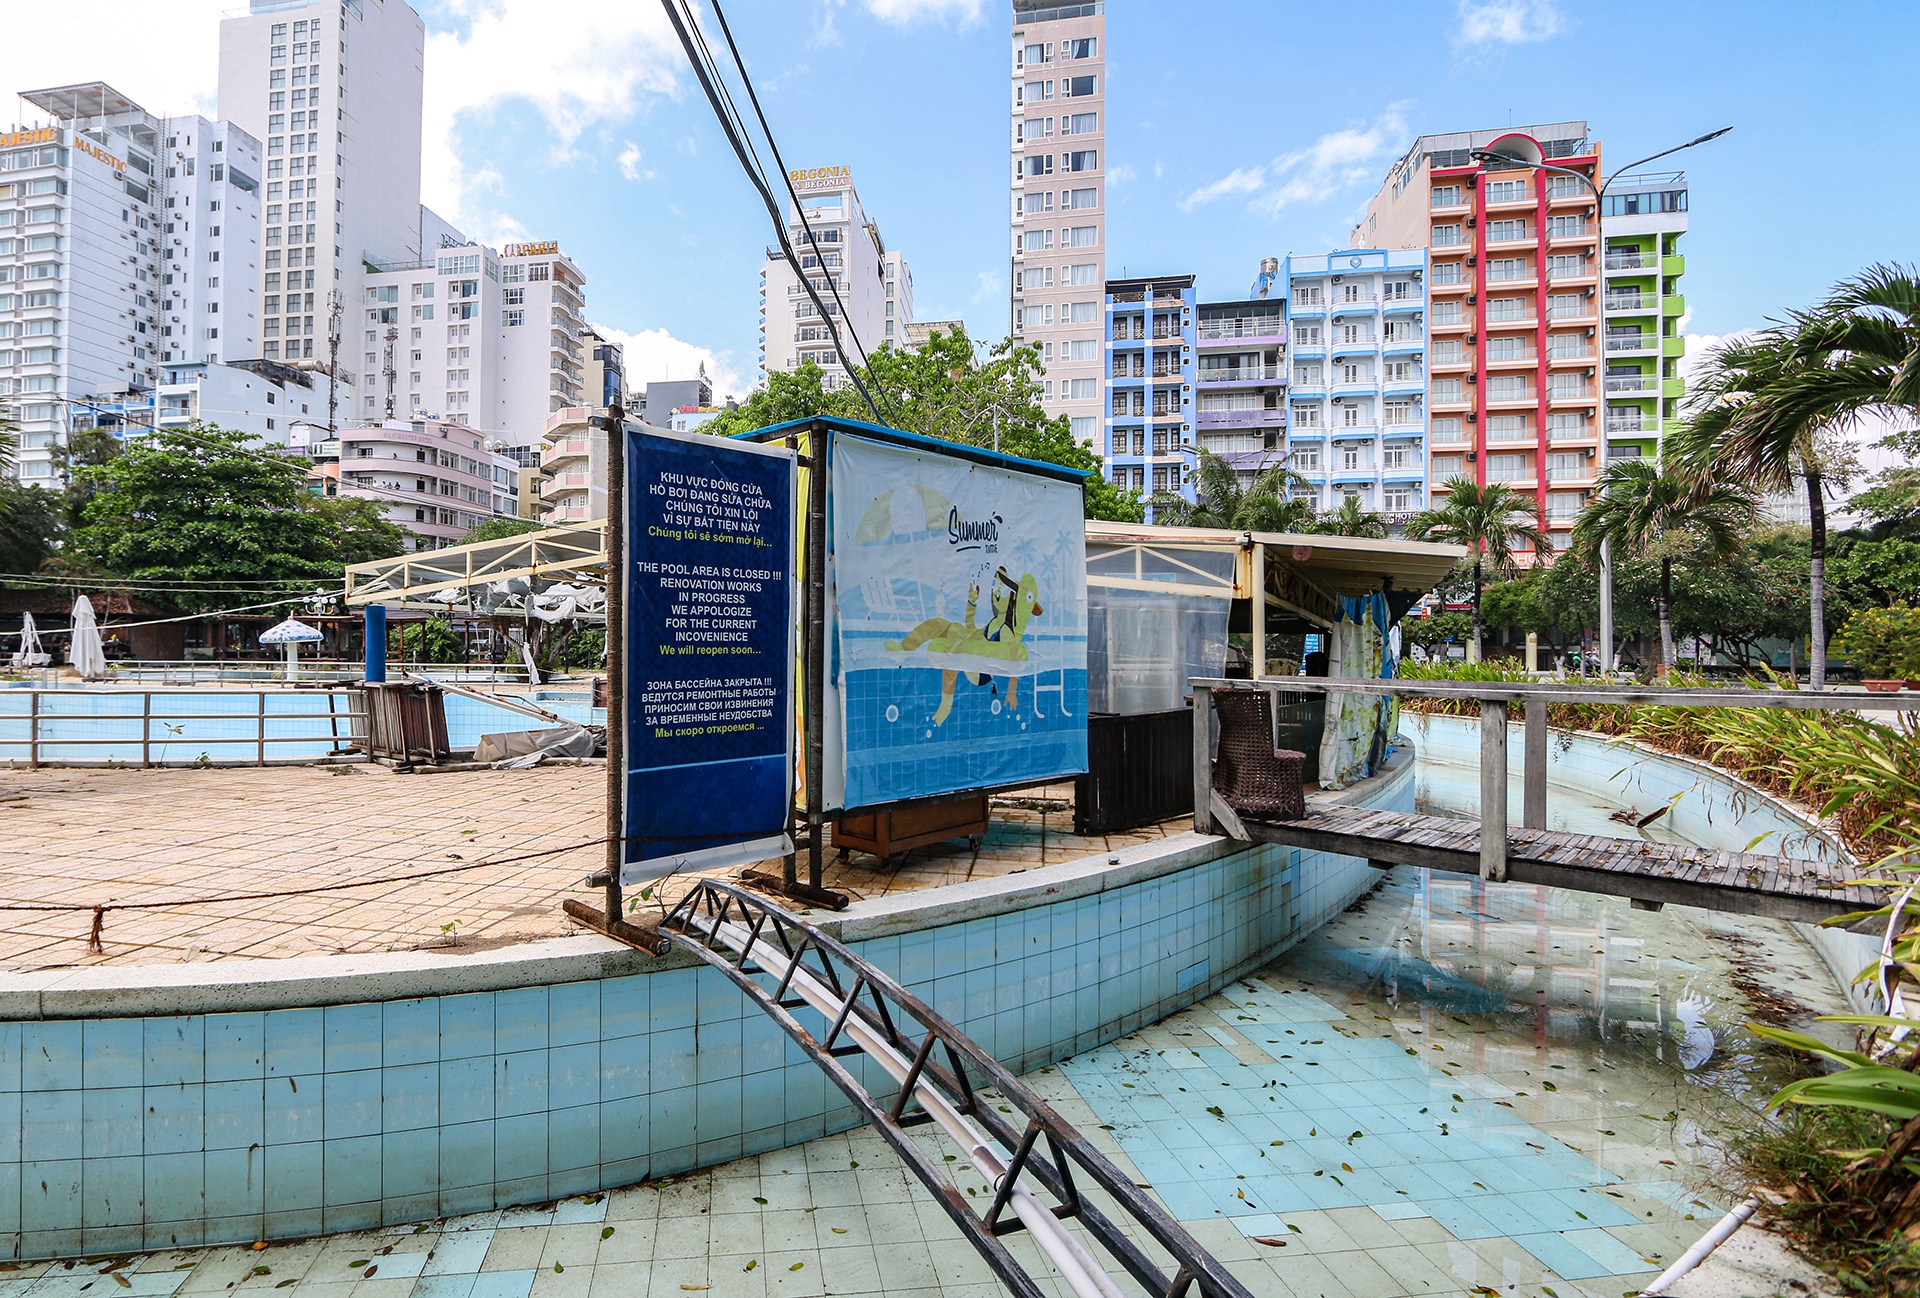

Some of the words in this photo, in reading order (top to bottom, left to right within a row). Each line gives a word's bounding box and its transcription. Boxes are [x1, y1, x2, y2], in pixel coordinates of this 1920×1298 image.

[75, 135, 128, 174] MAJESTIC
[790, 165, 850, 181] BEGONIA
[805, 178, 845, 189] BEGONIA
[522, 241, 558, 256] PARIS
[661, 472, 683, 484] KHU
[686, 475, 708, 488] VỰC
[710, 478, 739, 492] ĐÓNG
[742, 483, 763, 495] CỬA
[668, 486, 688, 498] BƠI
[690, 489, 719, 502] ĐANG
[722, 492, 743, 506] SỬA
[744, 497, 772, 509] CHỮA
[665, 500, 703, 513] CHÚNG
[706, 504, 722, 516] TÔI
[724, 507, 740, 518] XIN
[743, 508, 758, 520] LỖI
[663, 512, 673, 524] VÌ
[676, 515, 692, 528] SỰ
[717, 519, 739, 532] TIỆN
[741, 521, 761, 533] NÀY
[948, 504, 999, 545] Summer
[648, 525, 682, 541] Chúng
[684, 529, 697, 540] tôi
[699, 531, 711, 541] sẽ
[713, 532, 734, 543] sớm
[736, 535, 751, 545] mở
[637, 561, 659, 574] THE
[661, 563, 690, 575] POOL
[692, 565, 720, 577] AREA
[721, 566, 731, 578] IS
[733, 568, 771, 580] CLOSED
[660, 578, 725, 590] RENOVATION
[727, 580, 762, 592] WORKS
[679, 592, 689, 602] IN
[692, 592, 746, 604] PROGRESS
[671, 605, 688, 615] WE
[690, 605, 752, 617] APPOLOGIZE
[665, 618, 687, 628] FOR
[689, 619, 710, 629] THE
[711, 619, 757, 629] CURRENT
[675, 631, 748, 642] INCOVENIENCE
[659, 645, 675, 655] We
[678, 644, 694, 655] will
[696, 646, 729, 657] reopen
[730, 646, 762, 655] soon...
[646, 681, 673, 691] ЗОНА
[674, 677, 723, 689] БАССЕЙНА
[723, 678, 763, 688] ЗАКРЫТА
[641, 691, 685, 703] ВЕДУТСЯ
[686, 689, 741, 700] РЕМОНТНЫЕ
[743, 688, 777, 697] РАБОТЫ
[644, 703, 697, 714] ПРИНОСИМ
[698, 701, 723, 711] СВОИ
[724, 698, 774, 709] ИЗВИНЕНИЯ
[645, 716, 659, 726] ЗА
[660, 713, 717, 724] ВРЕМЕННЫЕ
[719, 710, 773, 721] НЕУДОБСТВА
[655, 728, 673, 738] Мы
[675, 725, 704, 737] скоро
[706, 723, 755, 735] откроемся
